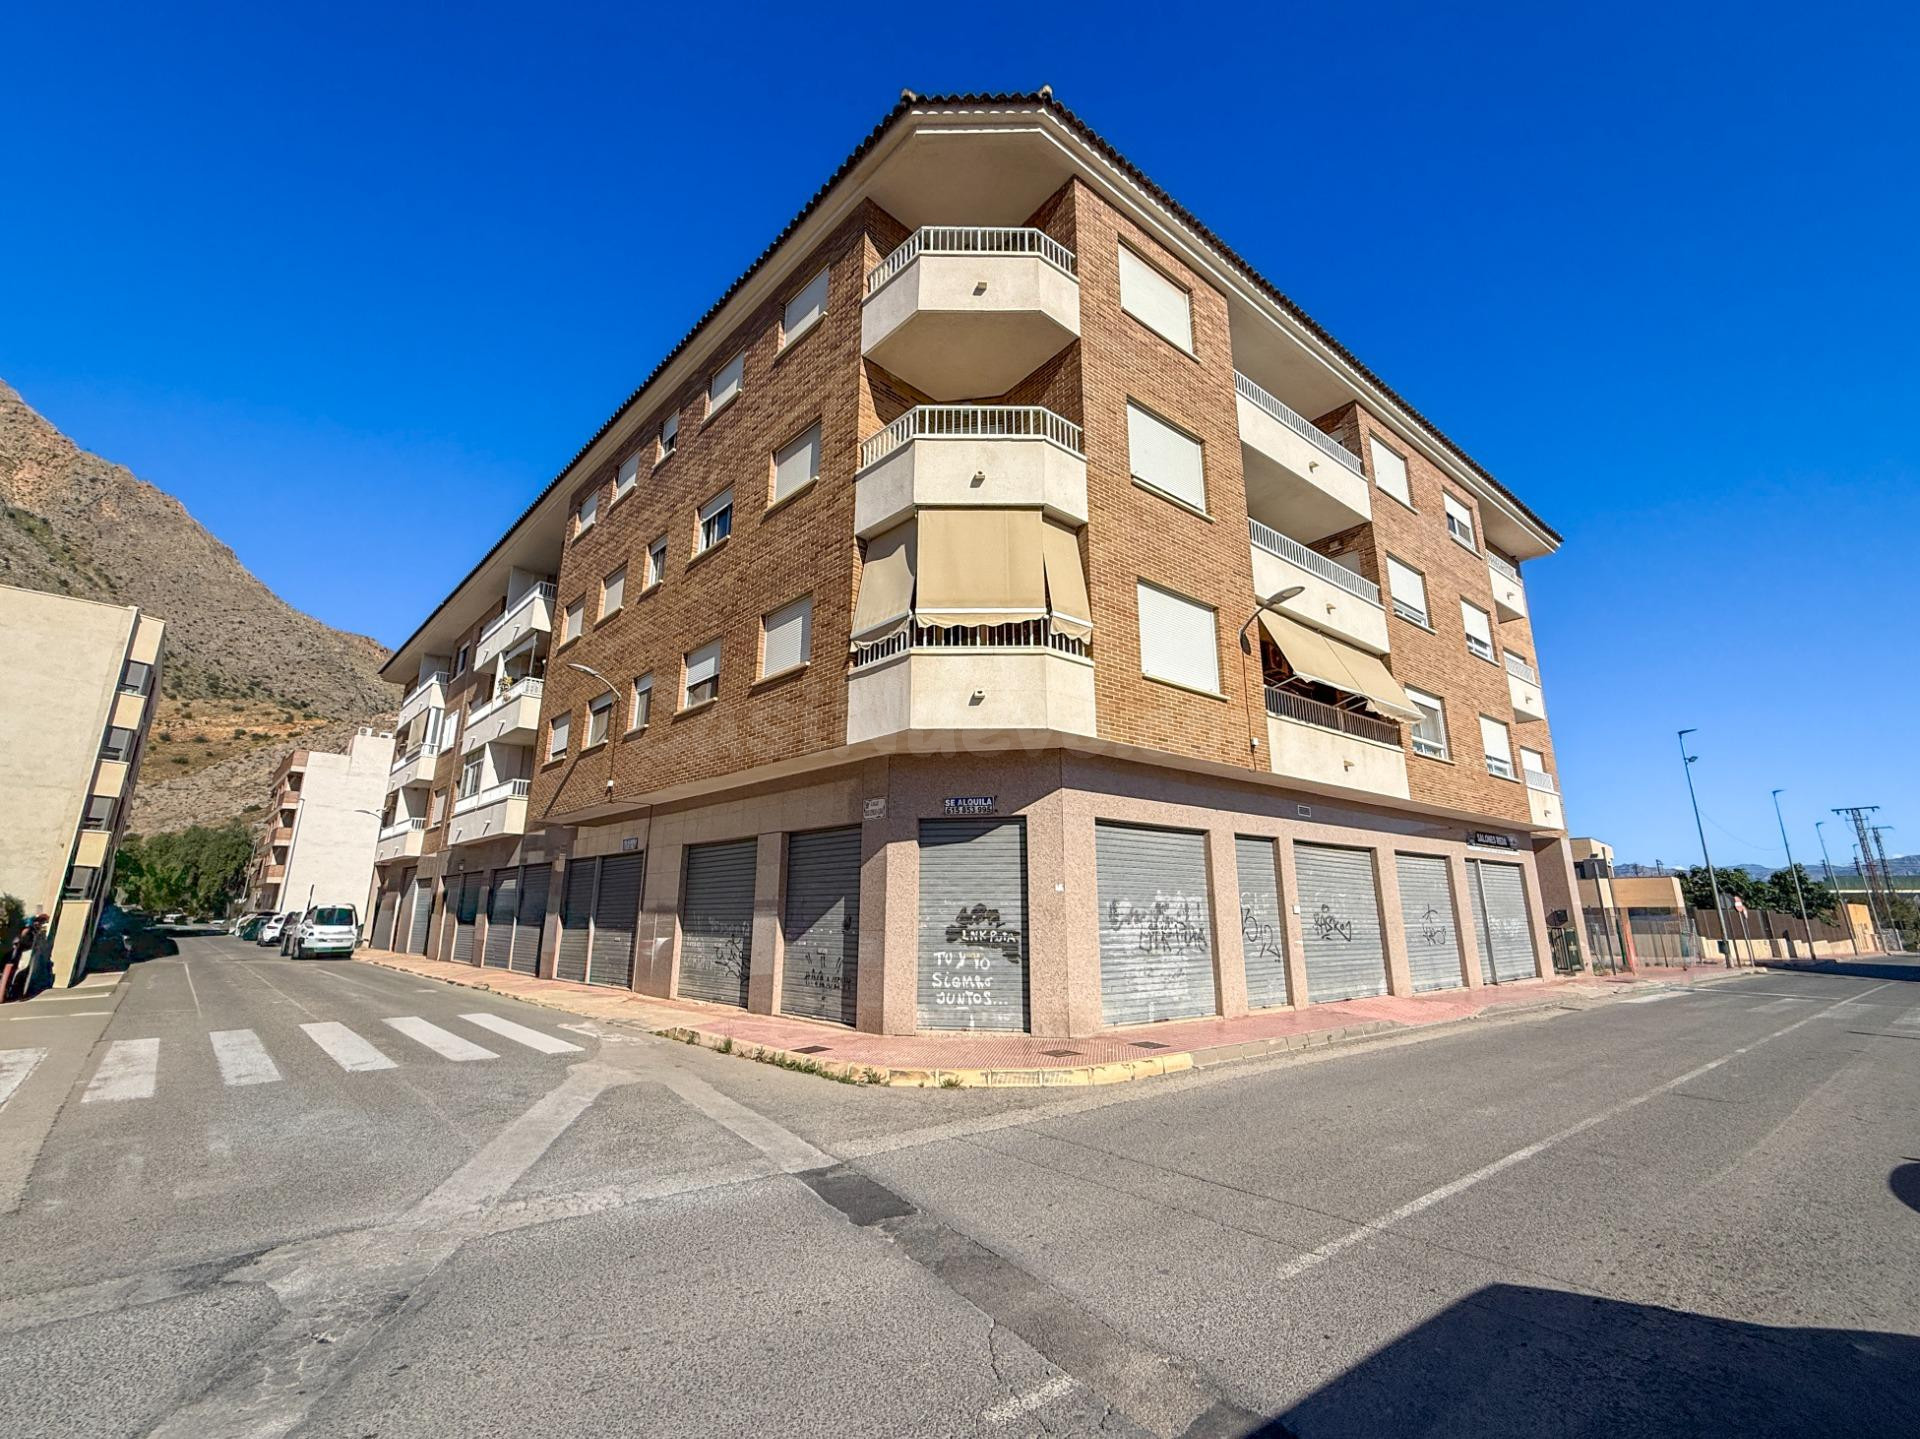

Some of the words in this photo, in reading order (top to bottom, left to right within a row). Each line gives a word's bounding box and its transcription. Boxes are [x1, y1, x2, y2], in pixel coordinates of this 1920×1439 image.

[945, 799, 955, 807] SE
[957, 798, 992, 806] ALQUILA
[934, 952, 953, 966] TU
